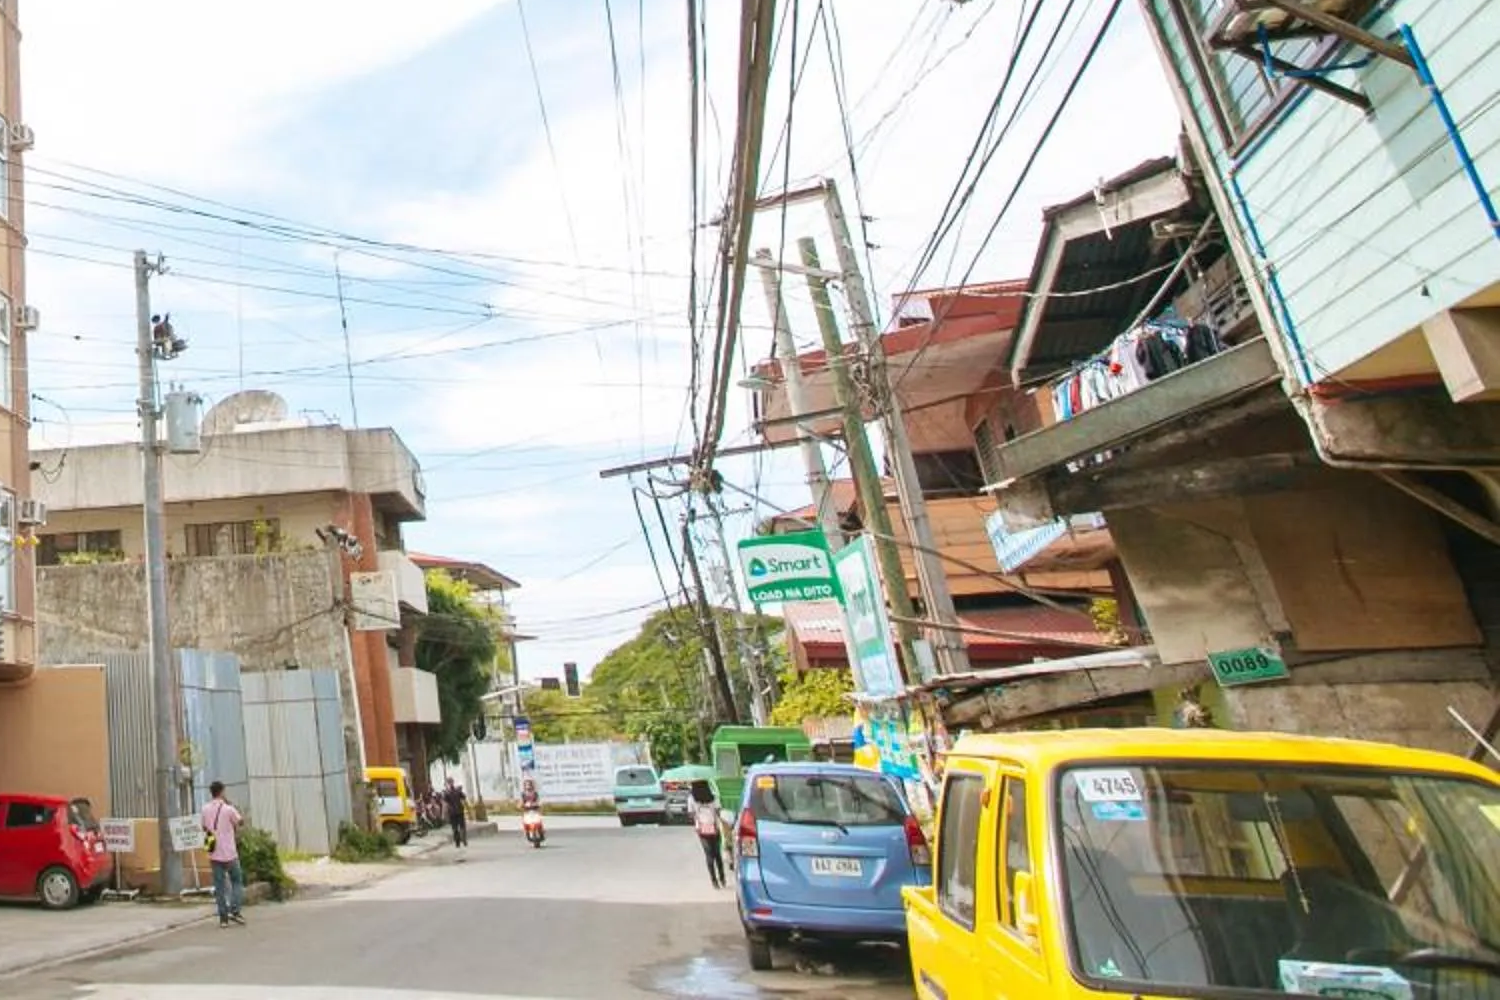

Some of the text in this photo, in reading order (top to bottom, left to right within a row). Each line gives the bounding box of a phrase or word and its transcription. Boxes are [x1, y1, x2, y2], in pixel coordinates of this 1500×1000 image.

[767, 555, 822, 573] Smart
[753, 585, 832, 600] LOAD NA DITO
[1092, 776, 1137, 795] 4745
